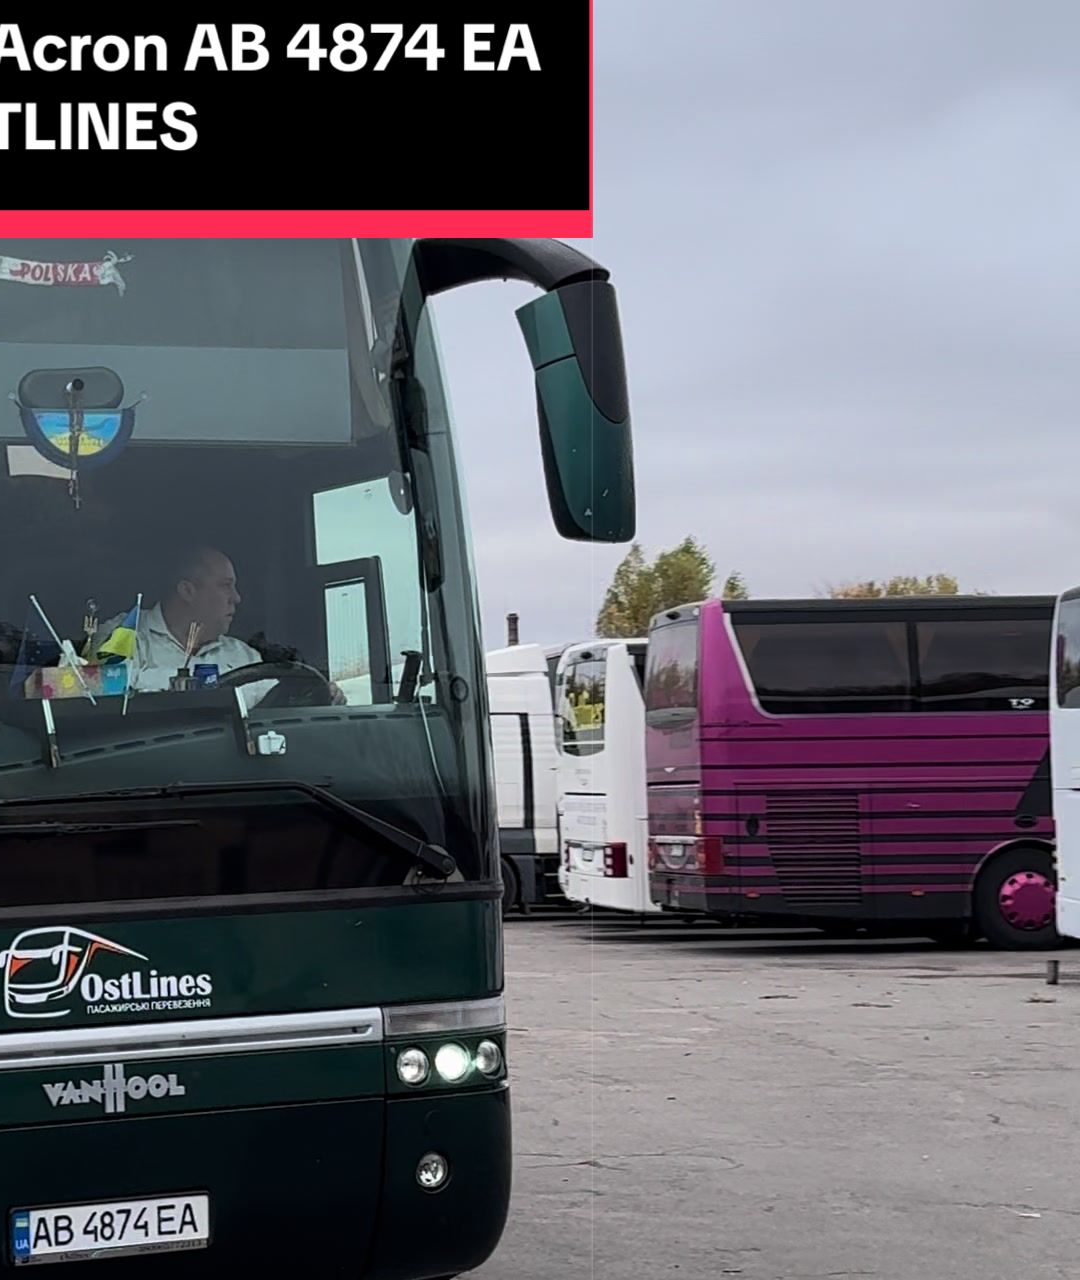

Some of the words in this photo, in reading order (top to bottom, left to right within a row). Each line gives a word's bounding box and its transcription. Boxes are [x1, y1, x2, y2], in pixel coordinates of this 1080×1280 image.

[22, 262, 92, 282] POLSKA
[80, 969, 213, 1001] OstLines
[87, 1002, 150, 1014] ПАСАЖИРСЬКІ
[151, 998, 211, 1010] ПЕРЕВЕЗЕННЯ
[32, 1214, 74, 1249] AB
[82, 1207, 149, 1242] 4874
[157, 1203, 198, 1235] EA
[15, 1239, 29, 1250] UA
